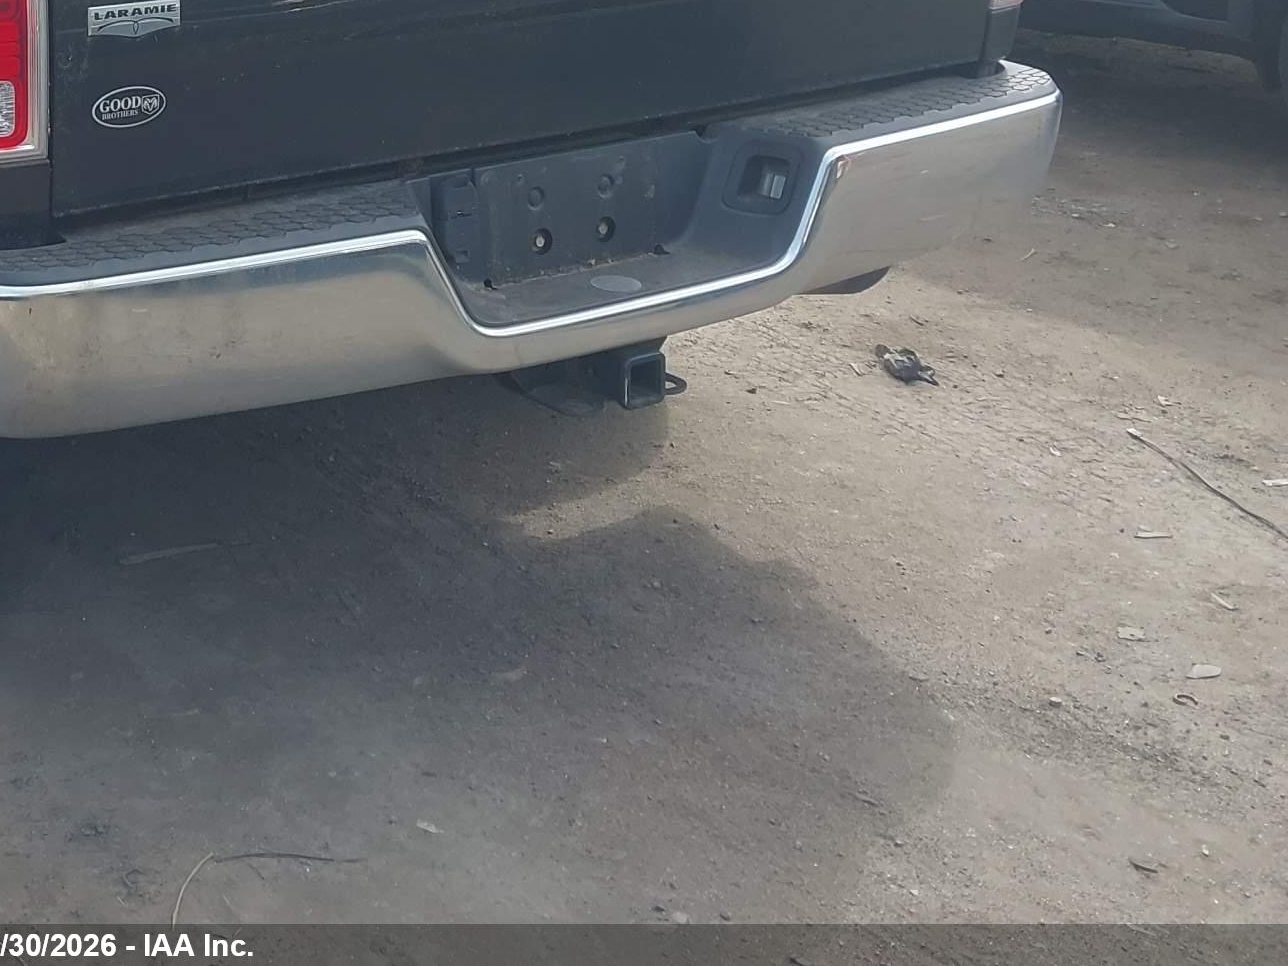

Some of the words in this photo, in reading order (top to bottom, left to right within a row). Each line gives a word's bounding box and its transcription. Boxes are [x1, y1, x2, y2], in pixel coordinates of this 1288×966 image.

[93, 3, 177, 21] LARAMIE
[99, 95, 142, 113] GOOD
[101, 109, 140, 121] BROTHERS
